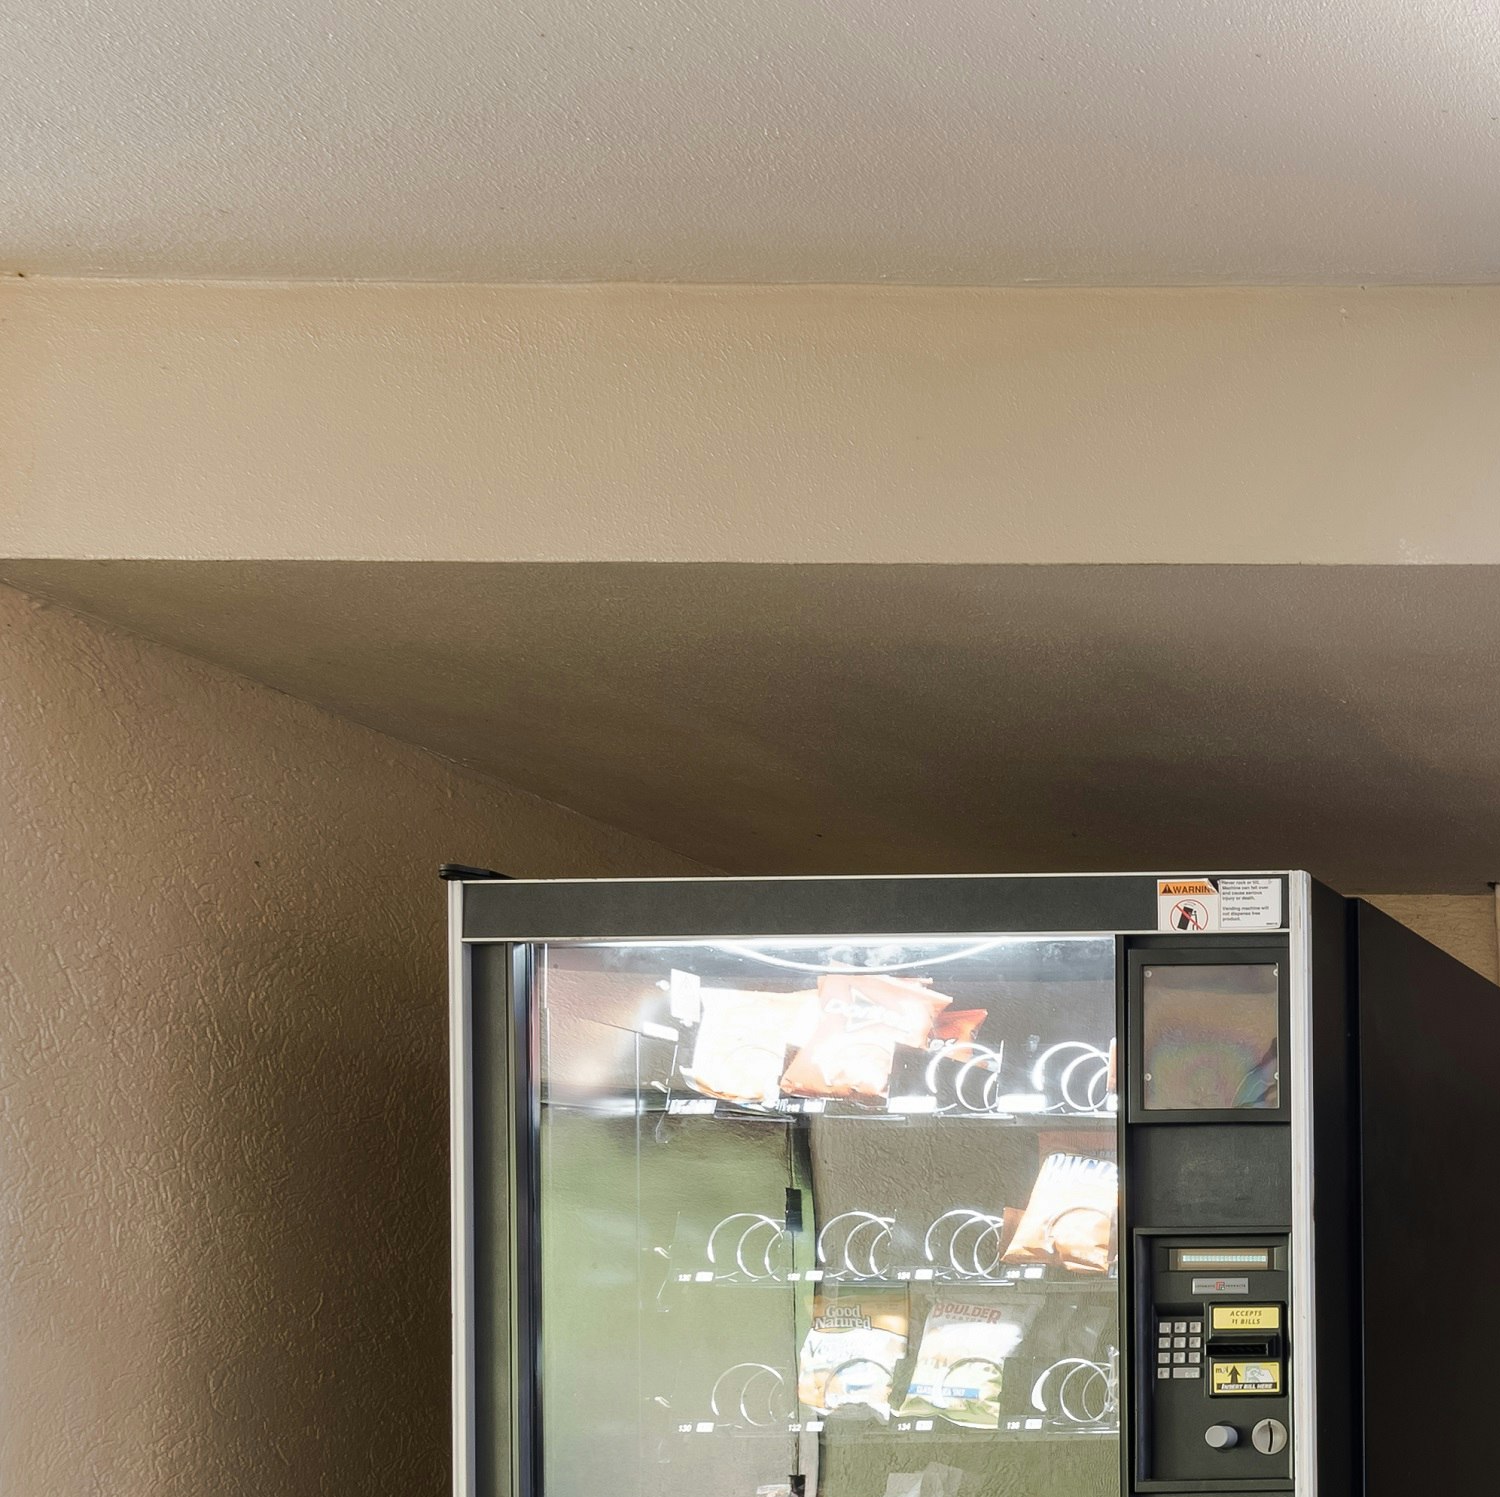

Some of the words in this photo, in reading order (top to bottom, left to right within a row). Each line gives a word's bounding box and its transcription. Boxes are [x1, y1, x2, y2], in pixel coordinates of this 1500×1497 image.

[825, 1304, 862, 1318] Good
[932, 1302, 1002, 1324] BOULDER
[814, 1315, 872, 1330] Natured
